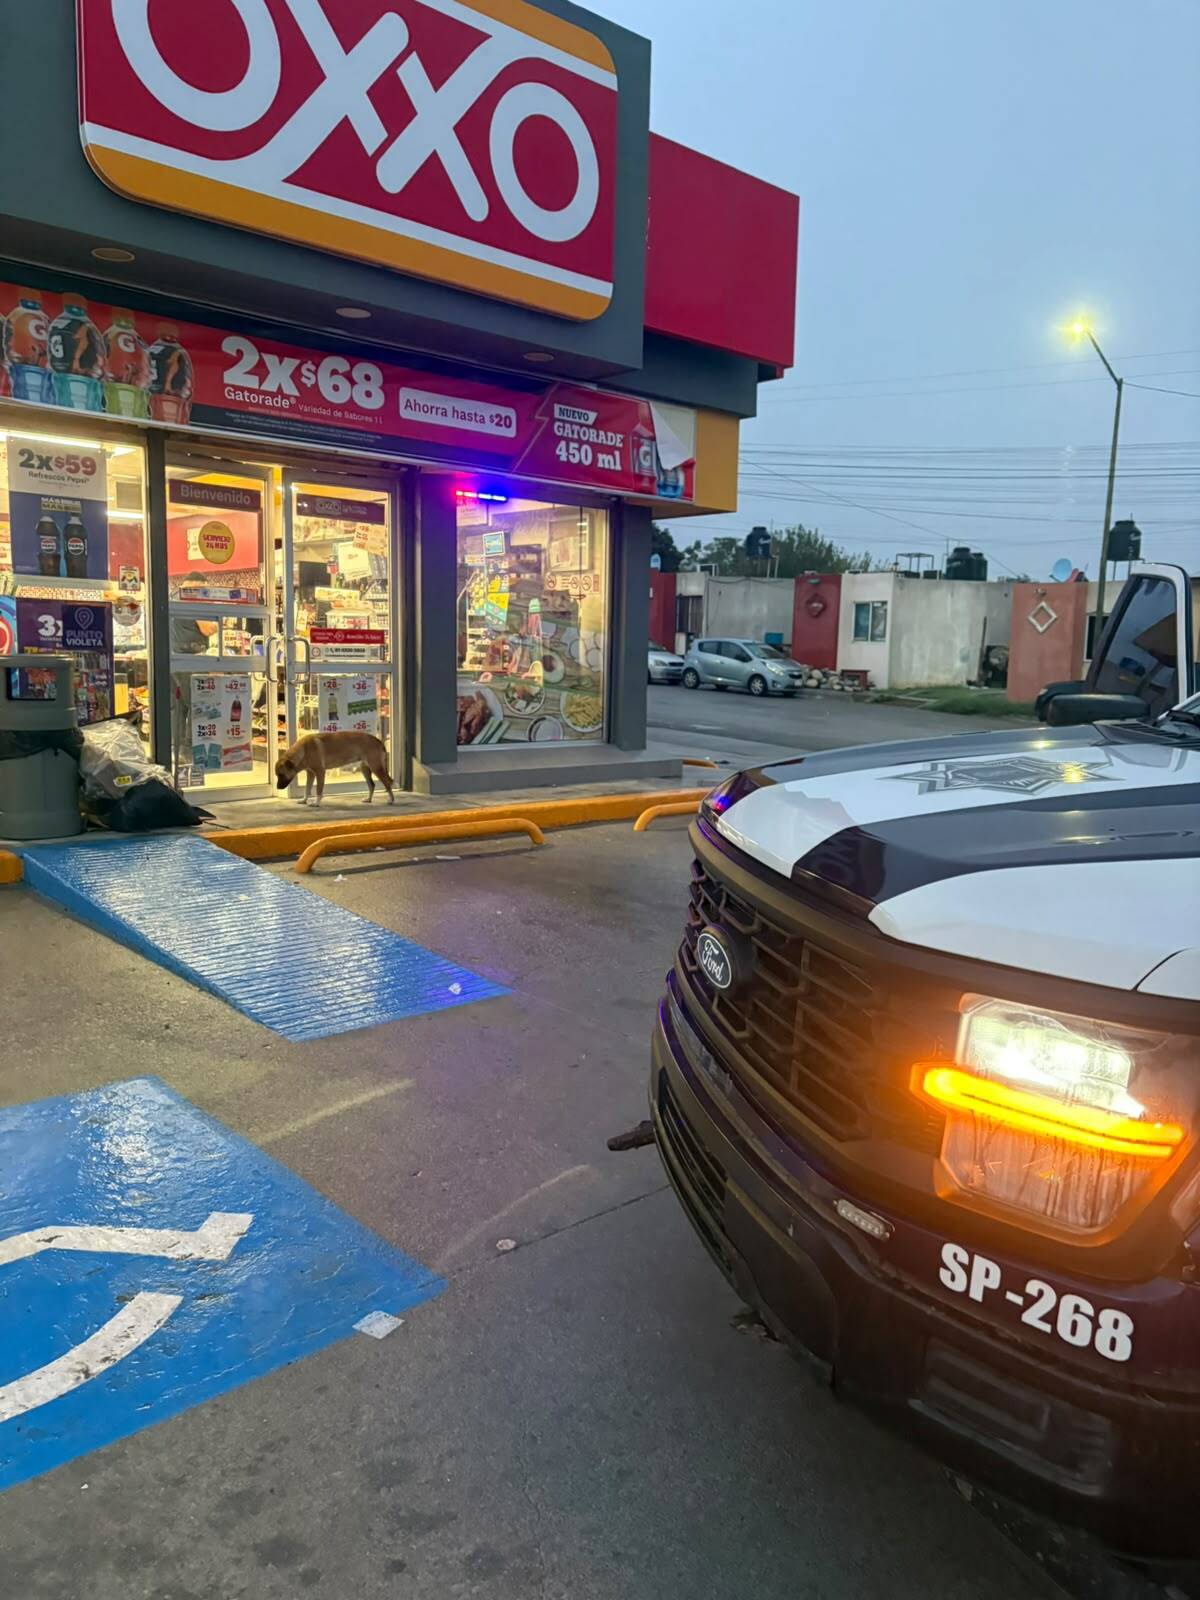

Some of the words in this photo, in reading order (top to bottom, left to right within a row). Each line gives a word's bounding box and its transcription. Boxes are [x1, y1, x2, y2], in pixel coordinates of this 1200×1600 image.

[112, 0, 599, 243] OXXO
[298, 403, 331, 416] Variedad
[333, 410, 343, 418] de
[404, 399, 448, 417] Ahorra
[451, 405, 486, 424] hasta
[489, 413, 513, 428] $20
[558, 406, 590, 422] NUEVO
[553, 421, 624, 447] GATORADE
[28, 470, 65, 482] Refrescos
[180, 484, 251, 505] Bienvenido
[66, 630, 103, 640] PUNTO
[66, 639, 103, 647] VIOLETA
[702, 939, 725, 981] Ford
[939, 1242, 1135, 1362] SP-268
